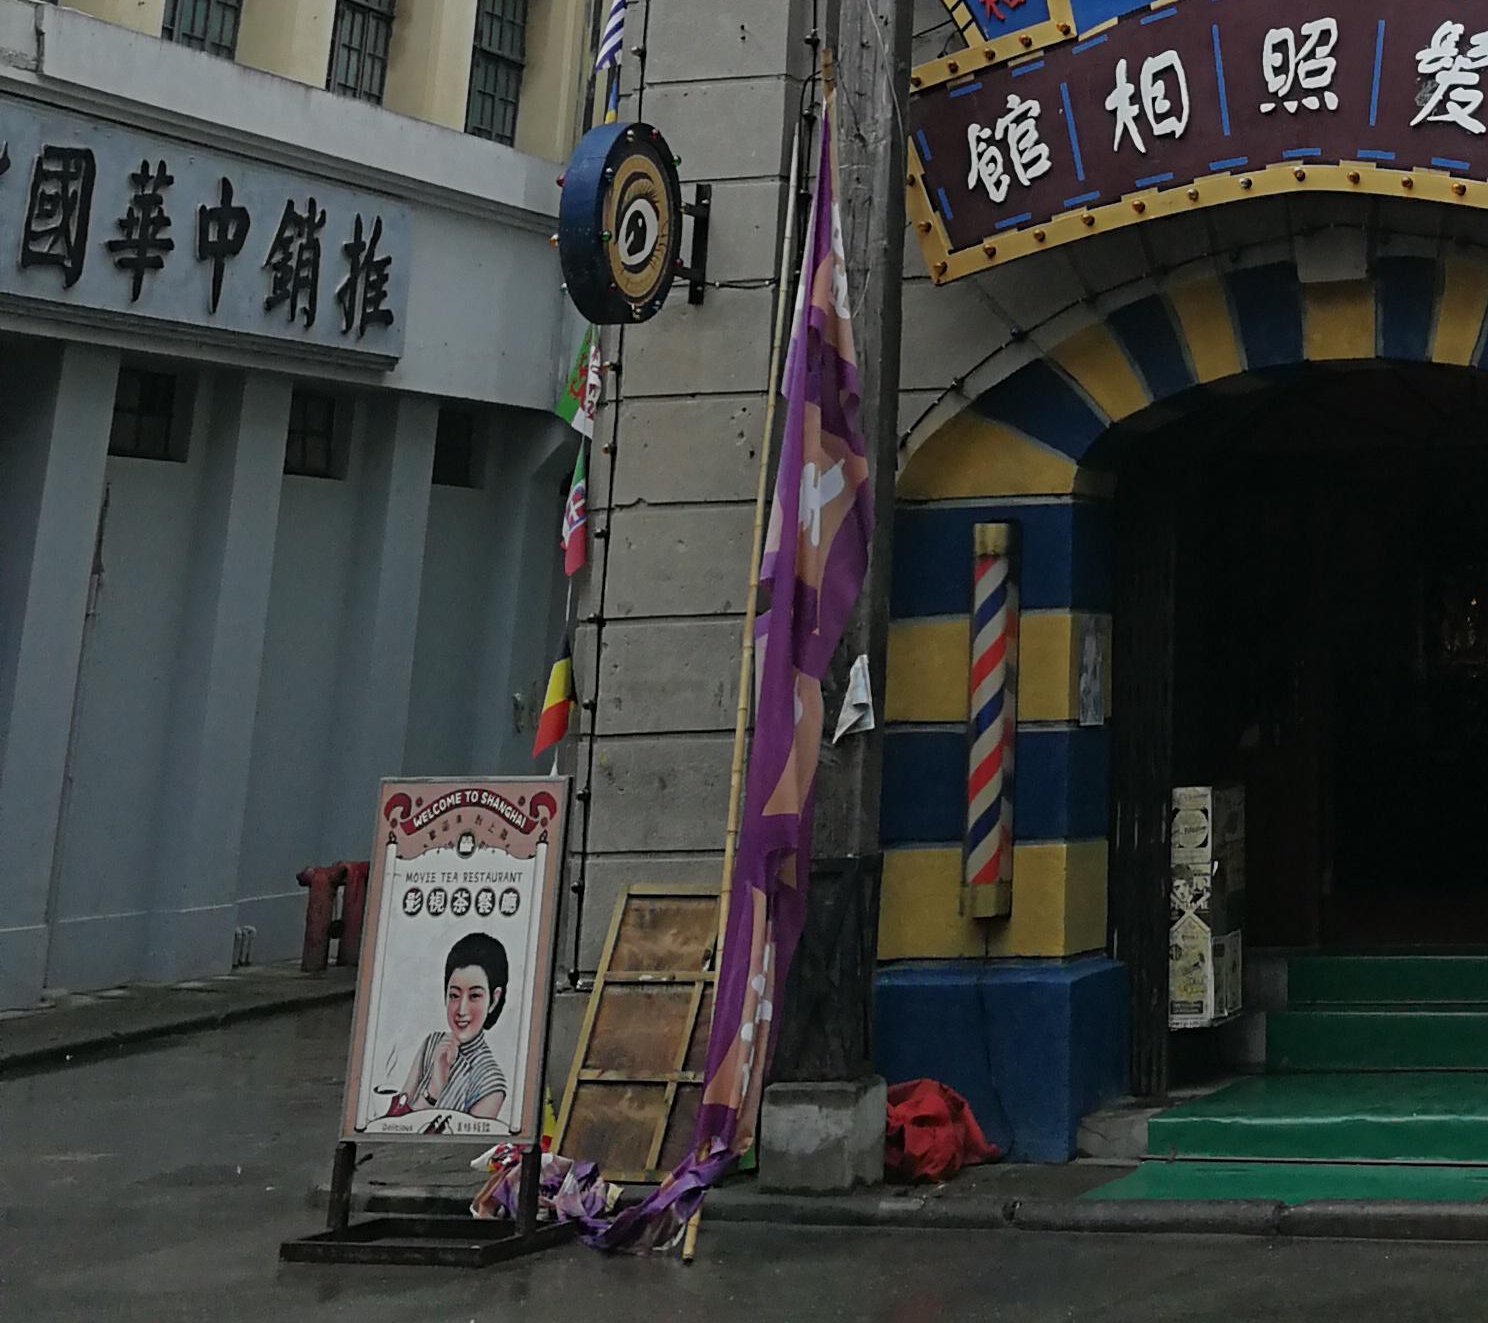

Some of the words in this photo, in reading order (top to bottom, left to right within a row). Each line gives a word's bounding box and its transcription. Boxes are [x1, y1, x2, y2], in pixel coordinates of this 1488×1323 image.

[413, 792, 462, 829] WELCOME
[464, 790, 479, 803] TO
[480, 791, 527, 829] SHANGHAI
[405, 871, 436, 884] MOVIE
[440, 871, 459, 884] TEA
[463, 871, 524, 884] RESTAURANT
[403, 888, 521, 916] 影視茶餐廳
